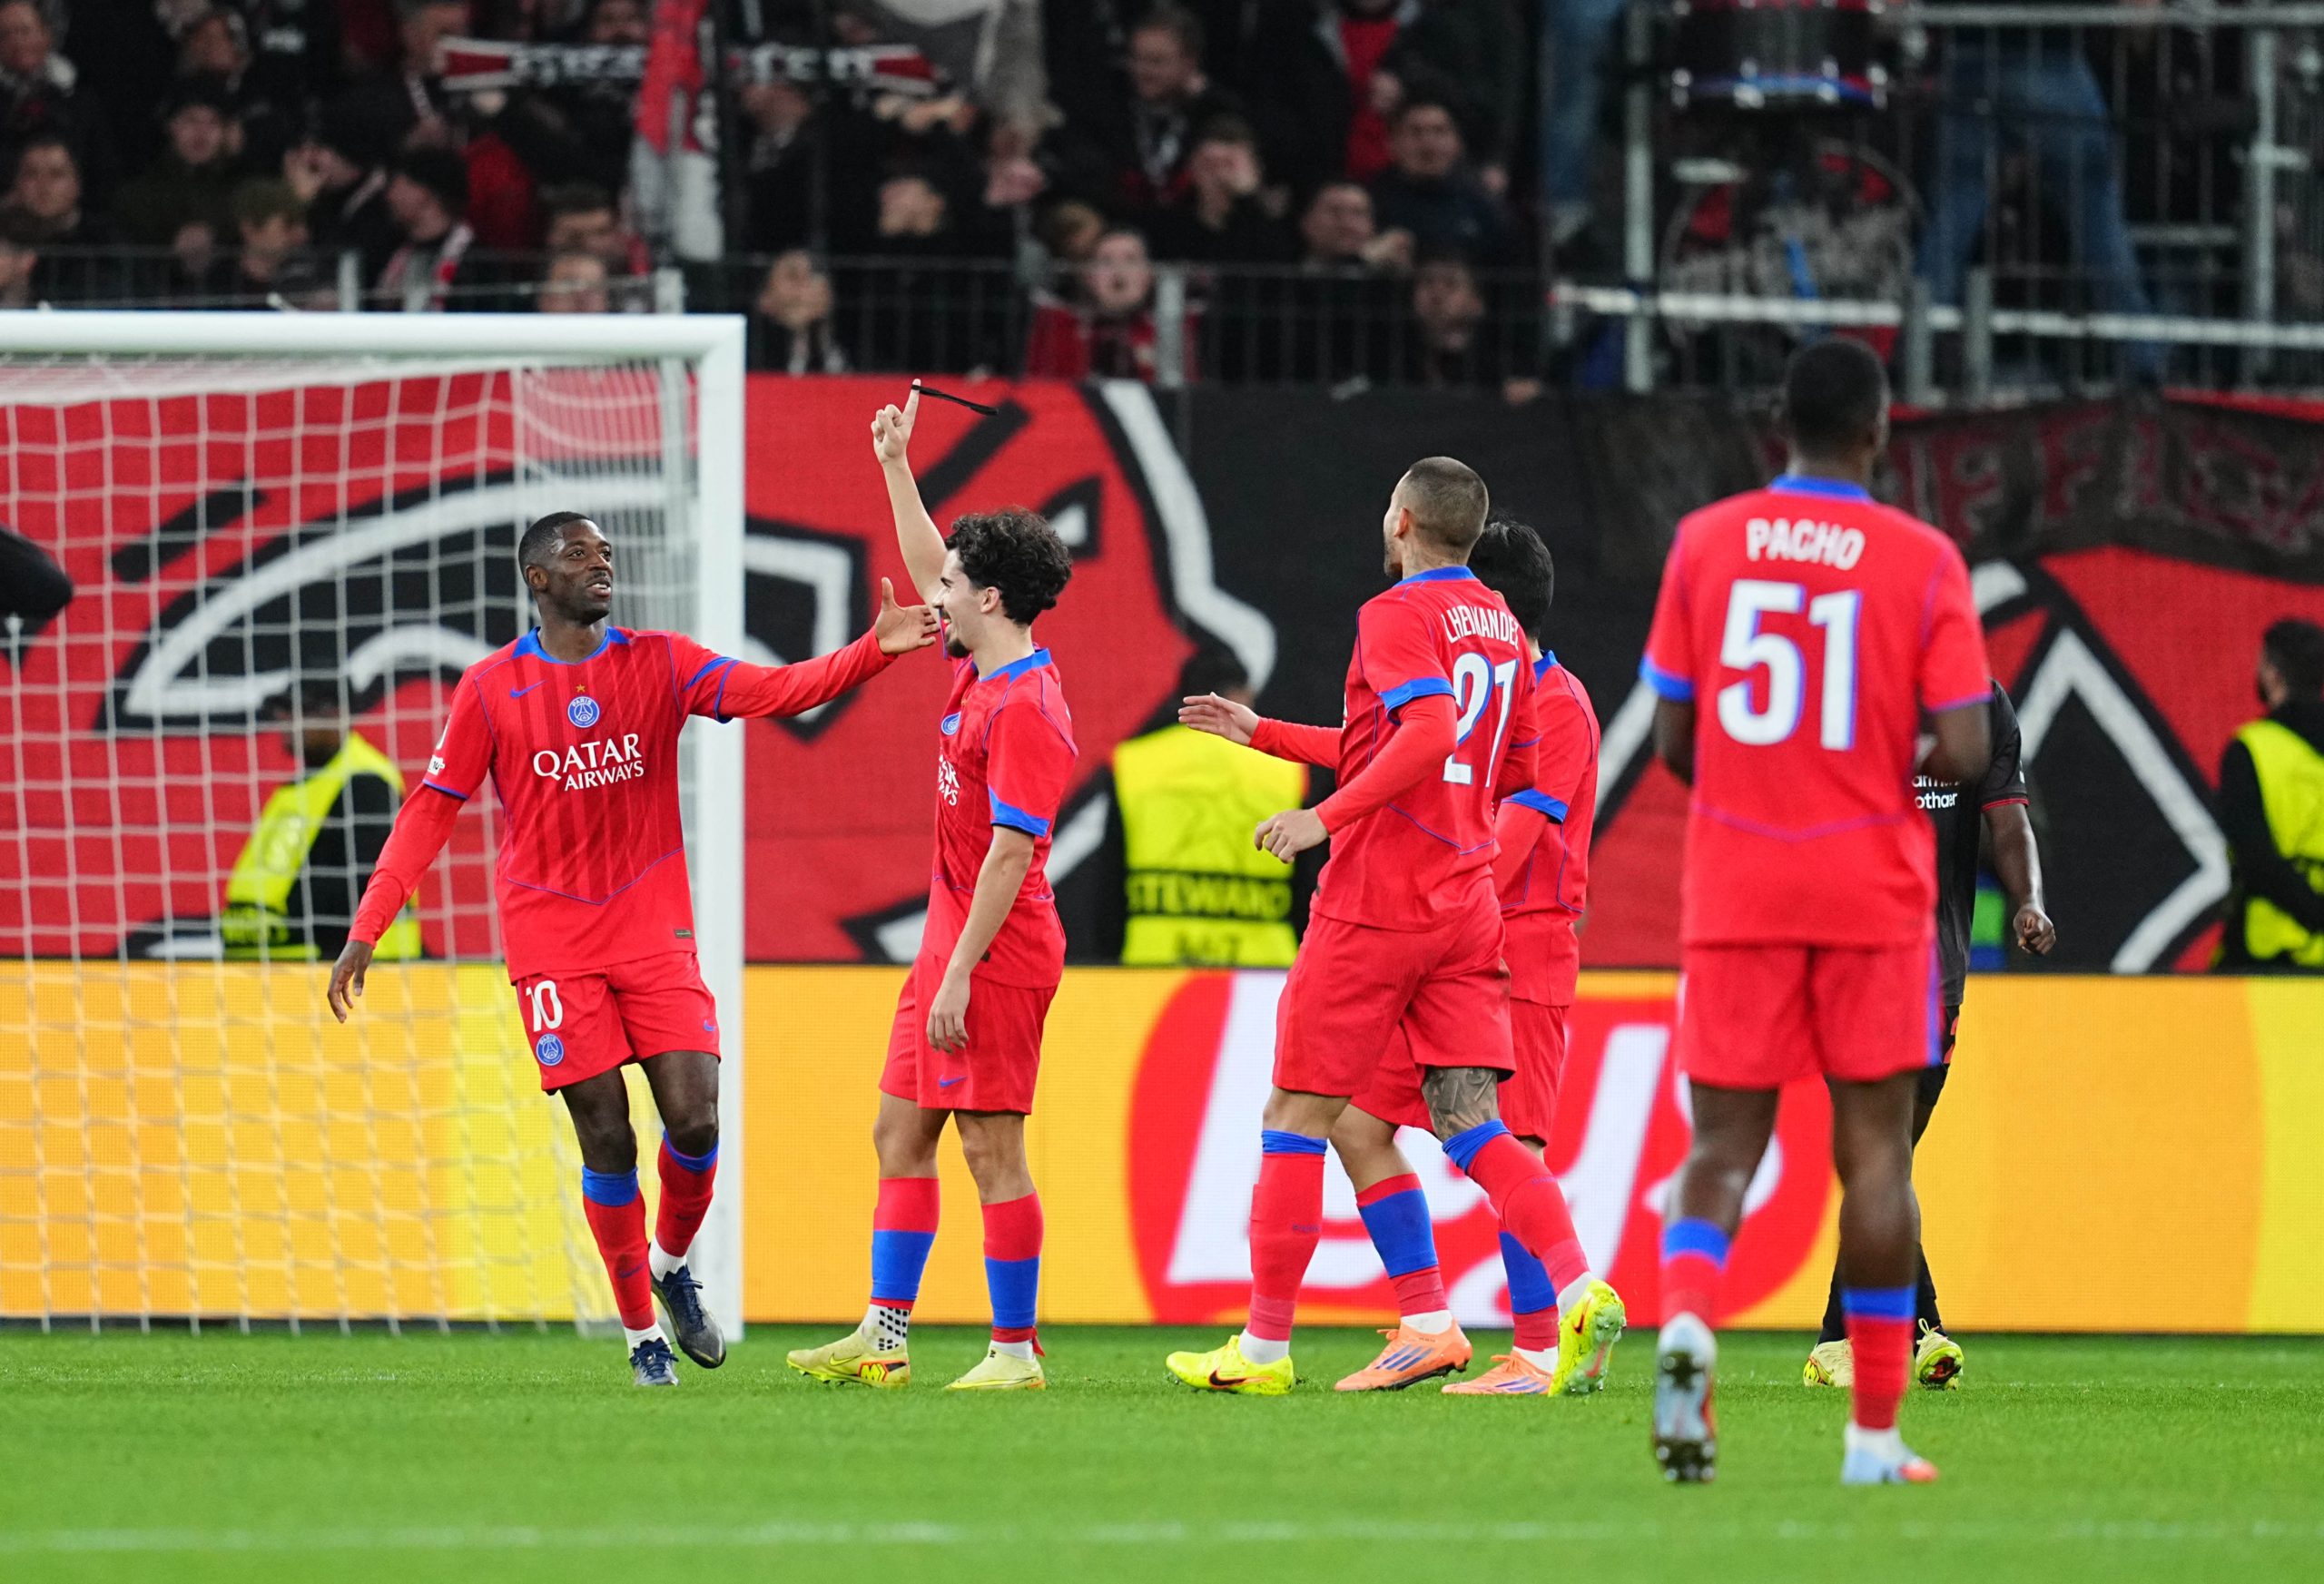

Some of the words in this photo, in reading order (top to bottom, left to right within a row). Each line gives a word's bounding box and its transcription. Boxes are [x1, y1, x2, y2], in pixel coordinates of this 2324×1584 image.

[1746, 517, 1866, 571] PACHO
[1717, 578, 1861, 752] 51
[571, 697, 593, 708] PARIS
[1442, 652, 1520, 788] 21
[533, 733, 643, 782] QATAR
[564, 760, 645, 792] AIRWAYS
[1915, 791, 1958, 810] othaer
[526, 980, 563, 1032] 10
